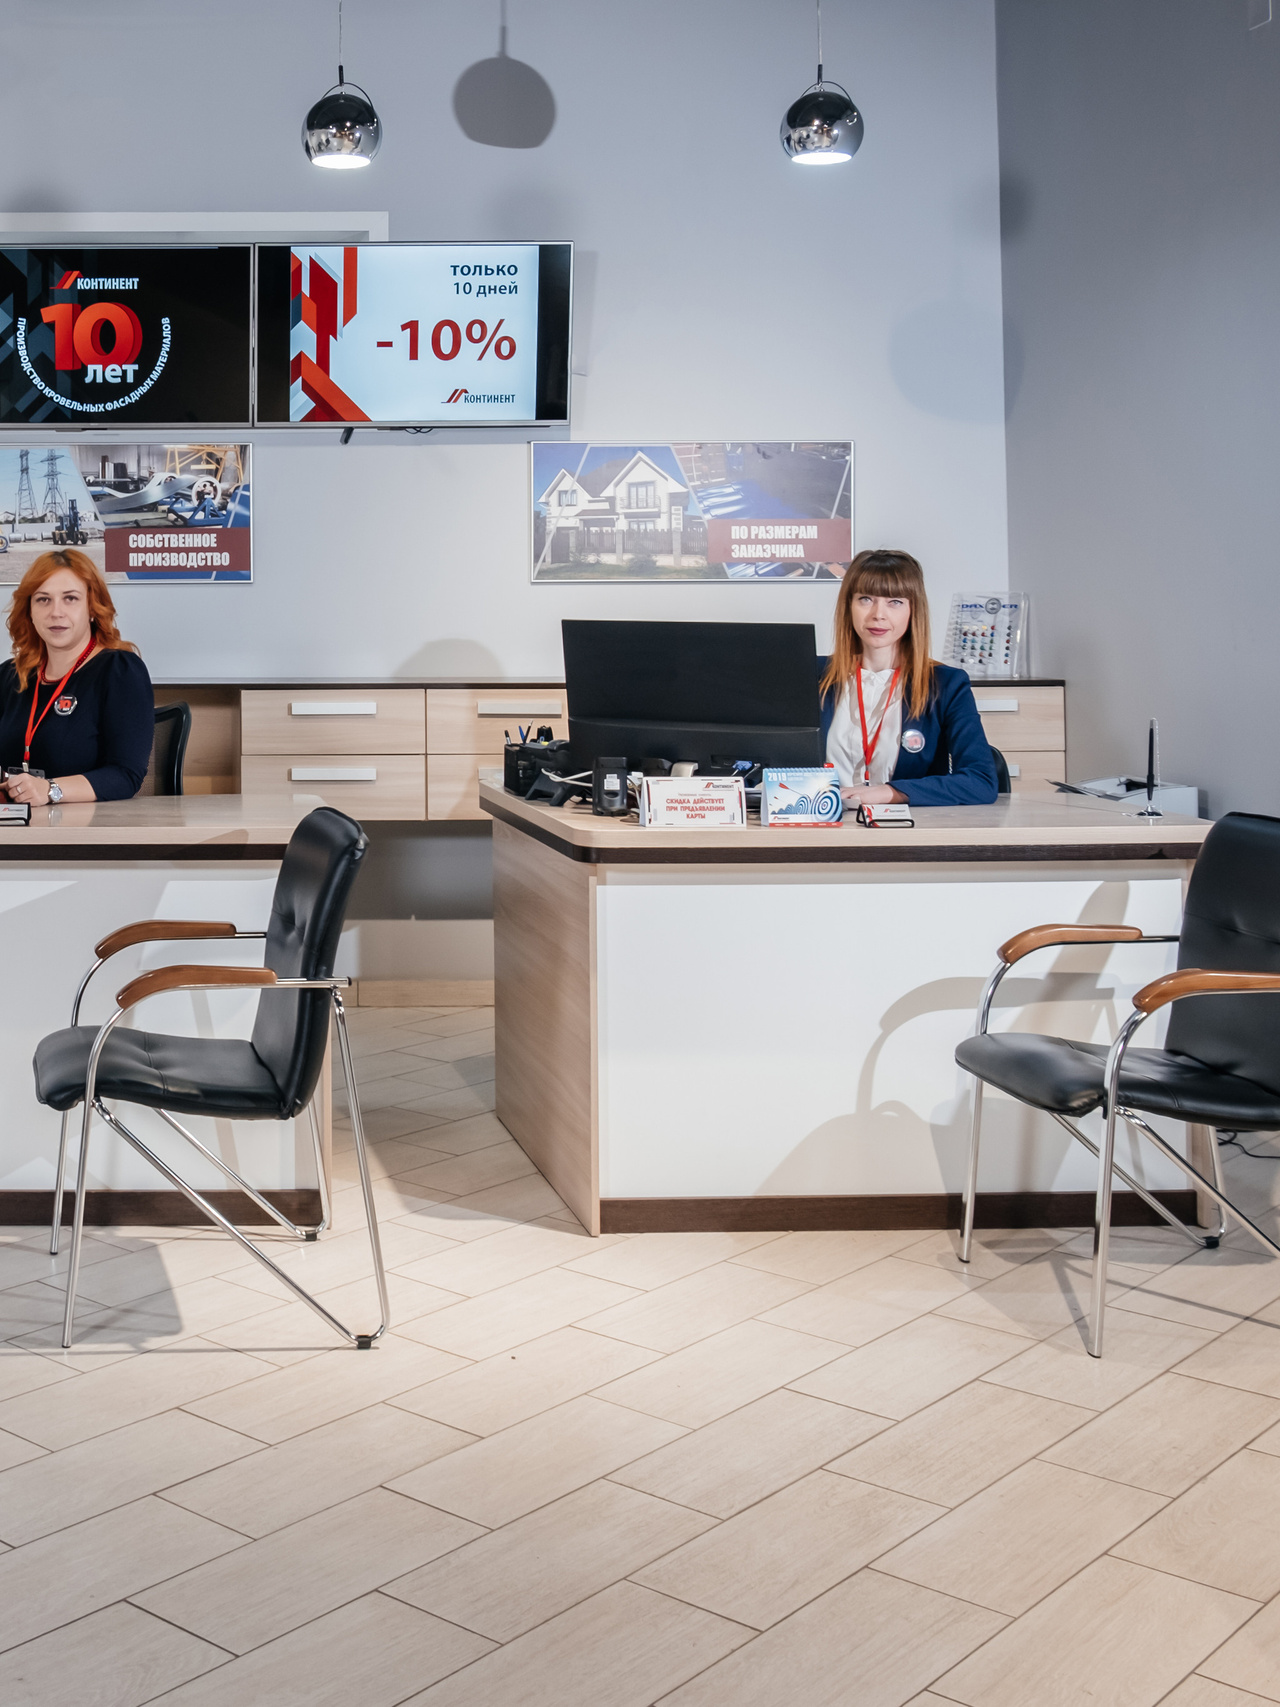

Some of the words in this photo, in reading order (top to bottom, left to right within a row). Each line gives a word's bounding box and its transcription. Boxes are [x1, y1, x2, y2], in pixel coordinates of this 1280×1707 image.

[77, 277, 139, 290] КОНТИНЕНТ
[453, 282, 472, 295] 10
[476, 281, 518, 297] дней
[40, 302, 143, 371] 10
[376, 318, 517, 361] -10%
[16, 317, 46, 391] ПРОИЗВОДСТВО
[42, 387, 105, 412] КРОВЕЛЬНЫХ
[105, 379, 155, 411] ФАСАДНЫХ
[150, 316, 172, 382] МАТЕРИАЛОВ
[84, 363, 139, 384] лет
[464, 394, 516, 404] КОНТИНЕНТ
[731, 525, 748, 540] ПО
[750, 525, 818, 540] РАЗМЕРАМ
[128, 533, 217, 548] СОБСТВЕННОЕ
[731, 544, 805, 559] ЗАКАЗЧИКА
[128, 552, 230, 568] ПРОИЗВОДСТВО
[692, 797, 724, 805] ДЕЙСТВУЕТ
